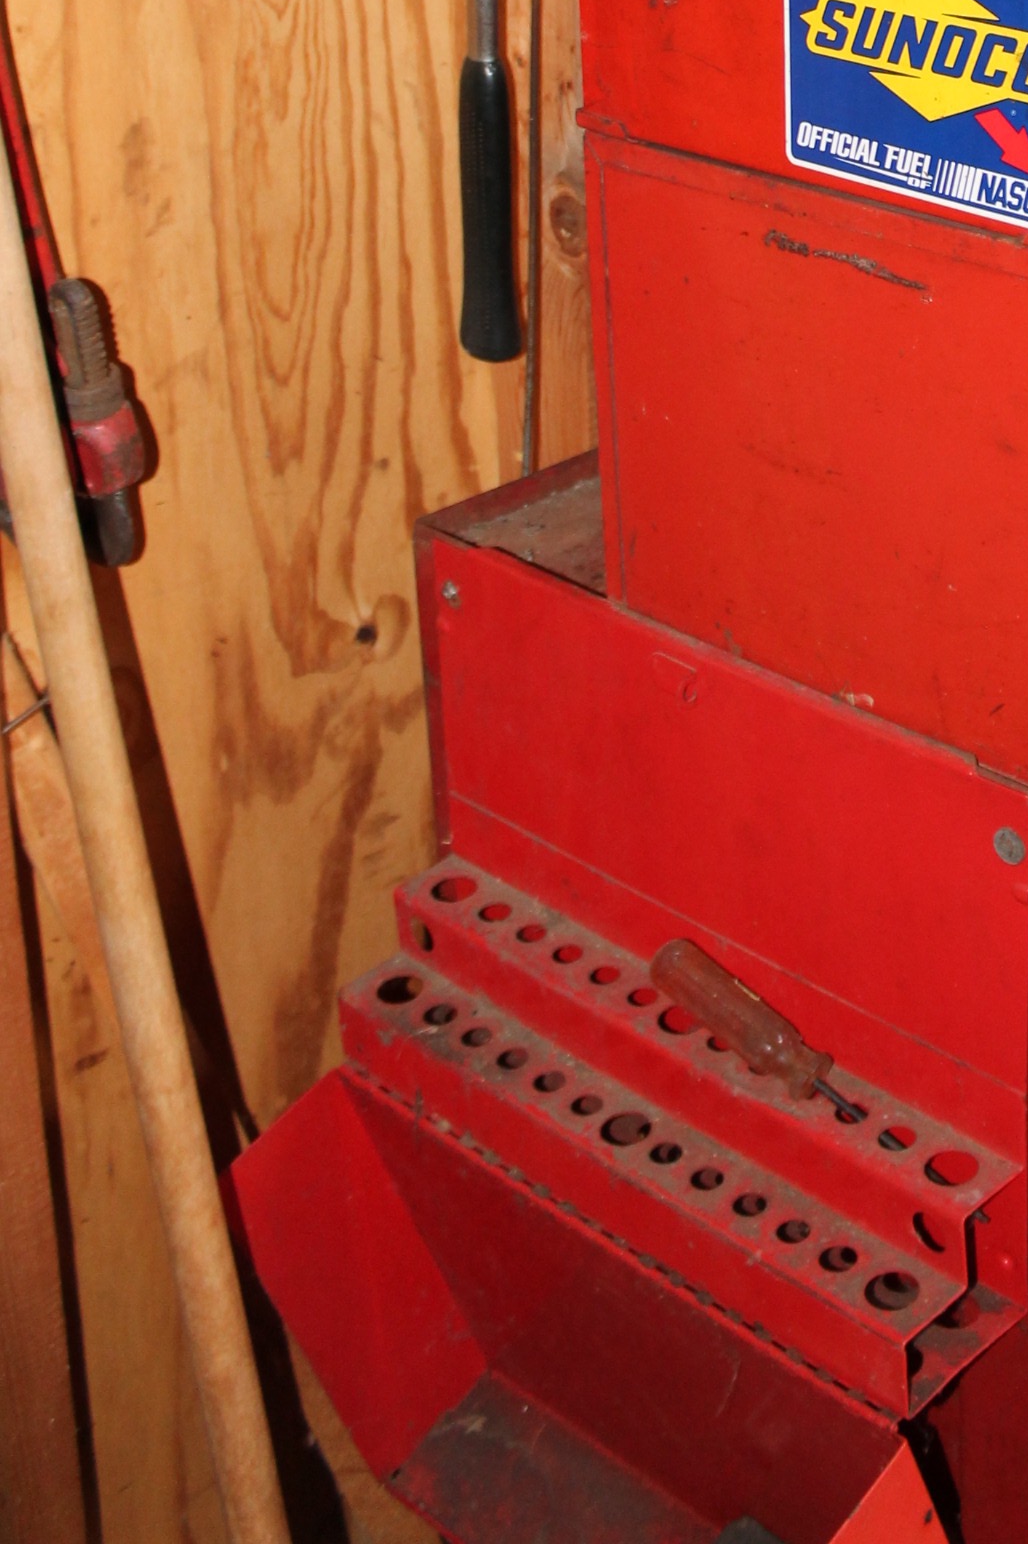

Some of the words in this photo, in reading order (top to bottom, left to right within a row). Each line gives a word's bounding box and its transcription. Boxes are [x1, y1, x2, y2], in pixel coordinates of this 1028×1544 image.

[796, 121, 880, 167] OFFICIAL
[883, 143, 934, 180] FUEL
[907, 177, 932, 190] OF
